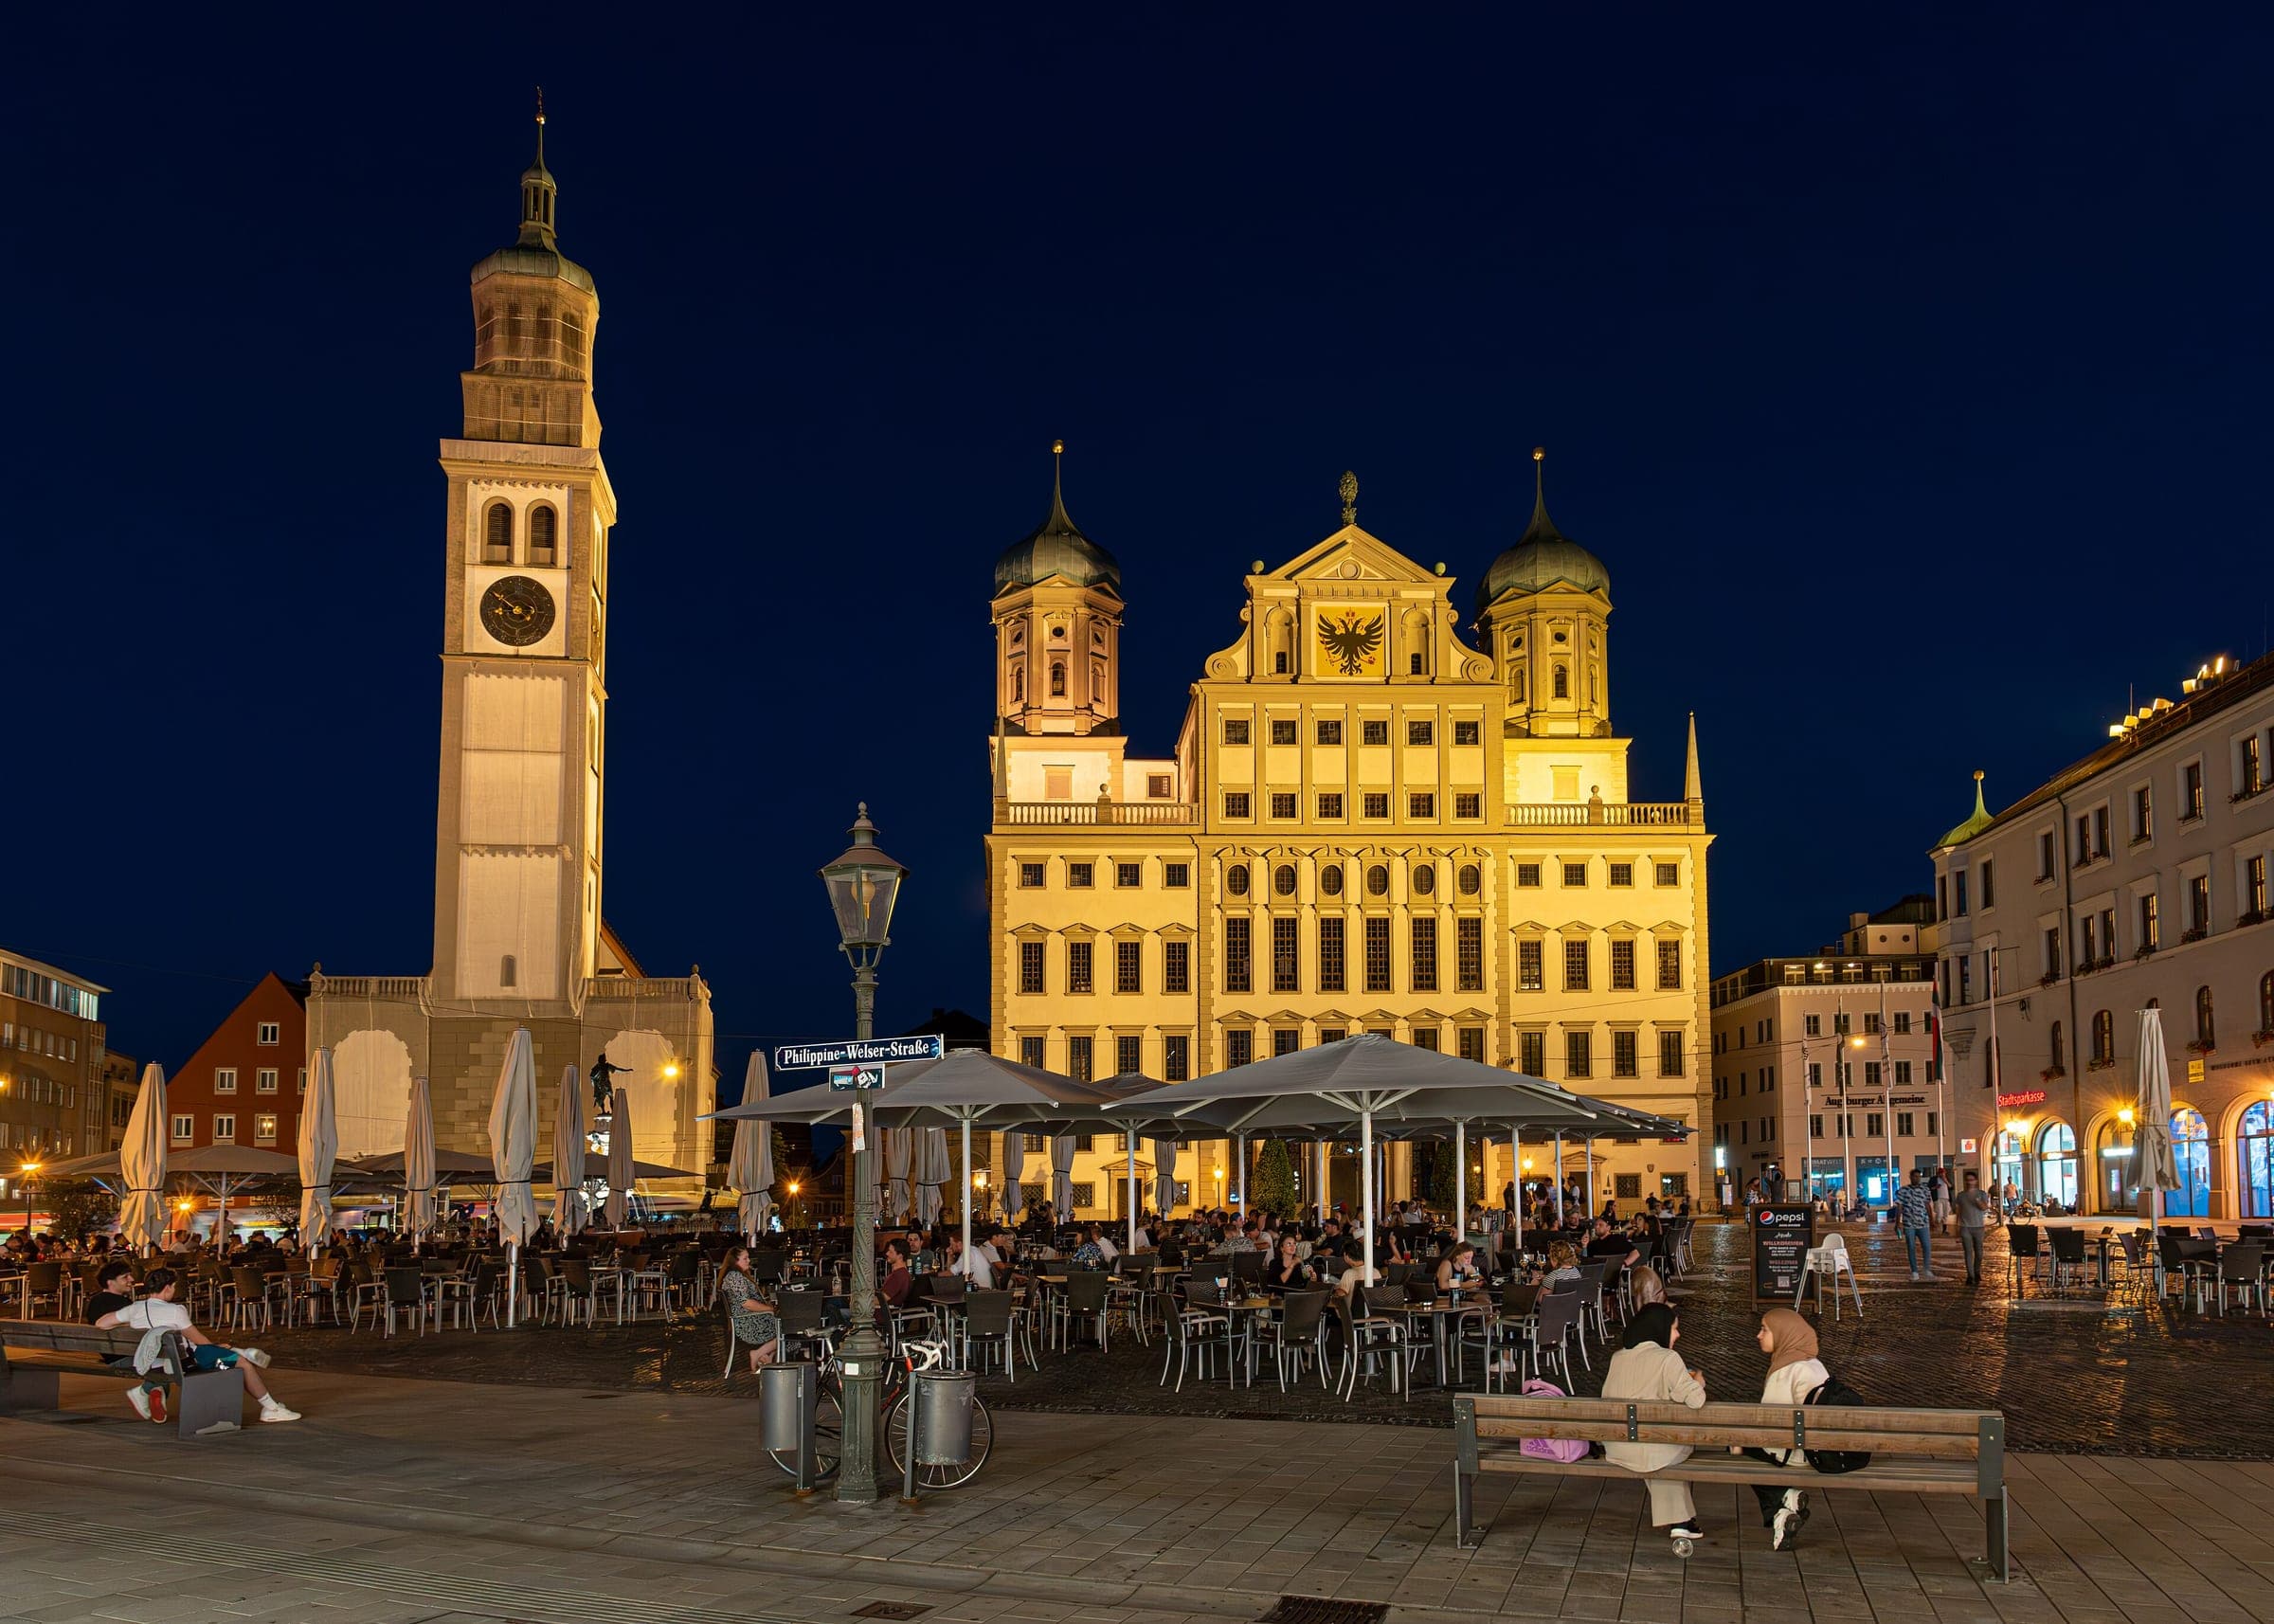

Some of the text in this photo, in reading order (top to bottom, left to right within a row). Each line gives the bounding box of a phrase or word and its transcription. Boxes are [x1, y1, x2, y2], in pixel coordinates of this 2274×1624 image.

[784, 1039, 929, 1066] Philippine-Welser-Straße
[1825, 1094, 1926, 1108] Augburger Algemeine
[1998, 1092, 2046, 1107] Stadtsparkasse
[1775, 1212, 1805, 1223] pepsi
